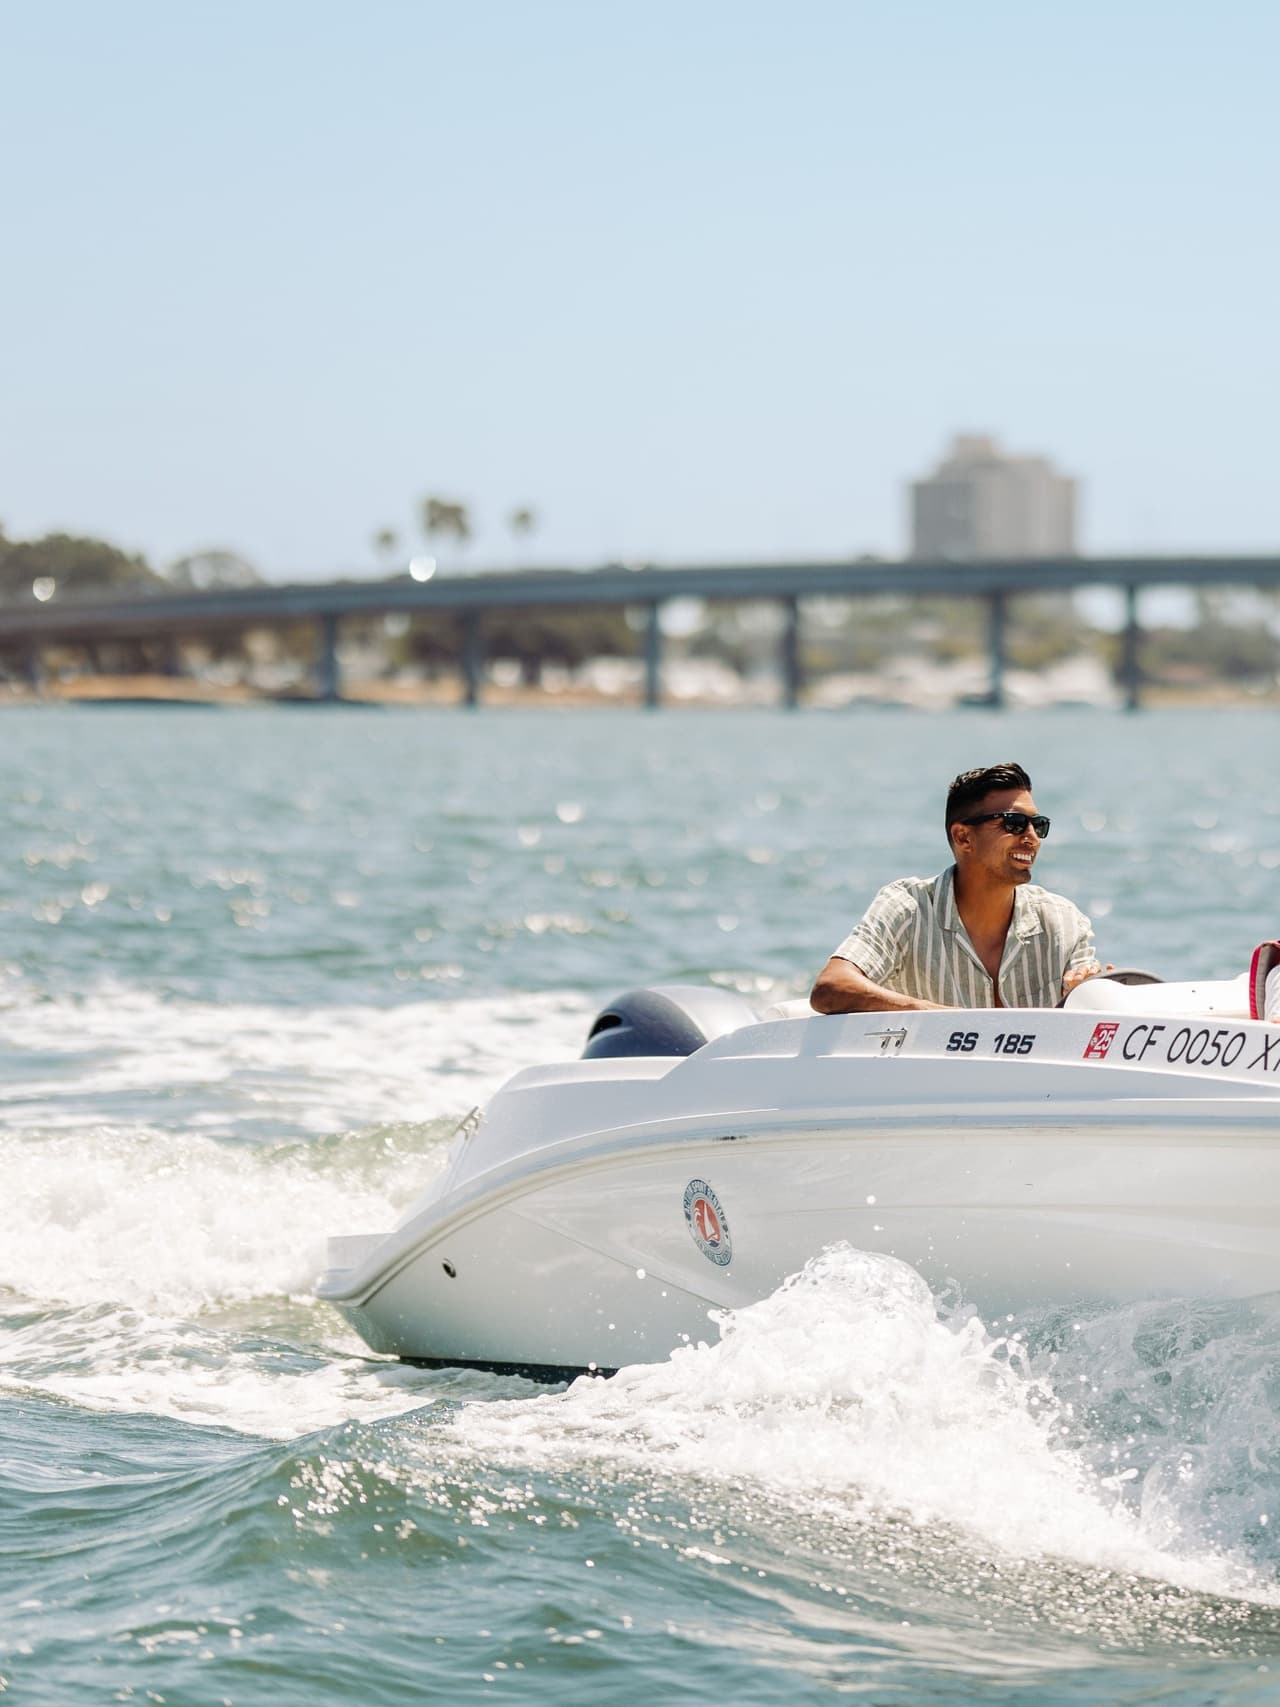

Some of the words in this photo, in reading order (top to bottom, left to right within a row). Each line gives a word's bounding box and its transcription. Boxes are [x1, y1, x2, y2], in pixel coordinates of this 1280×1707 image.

[946, 1032, 979, 1051] SS
[994, 1034, 1036, 1054] 185
[1094, 1030, 1116, 1050] 25
[1122, 1024, 1166, 1061] CF
[1166, 1027, 1246, 1067] 0050
